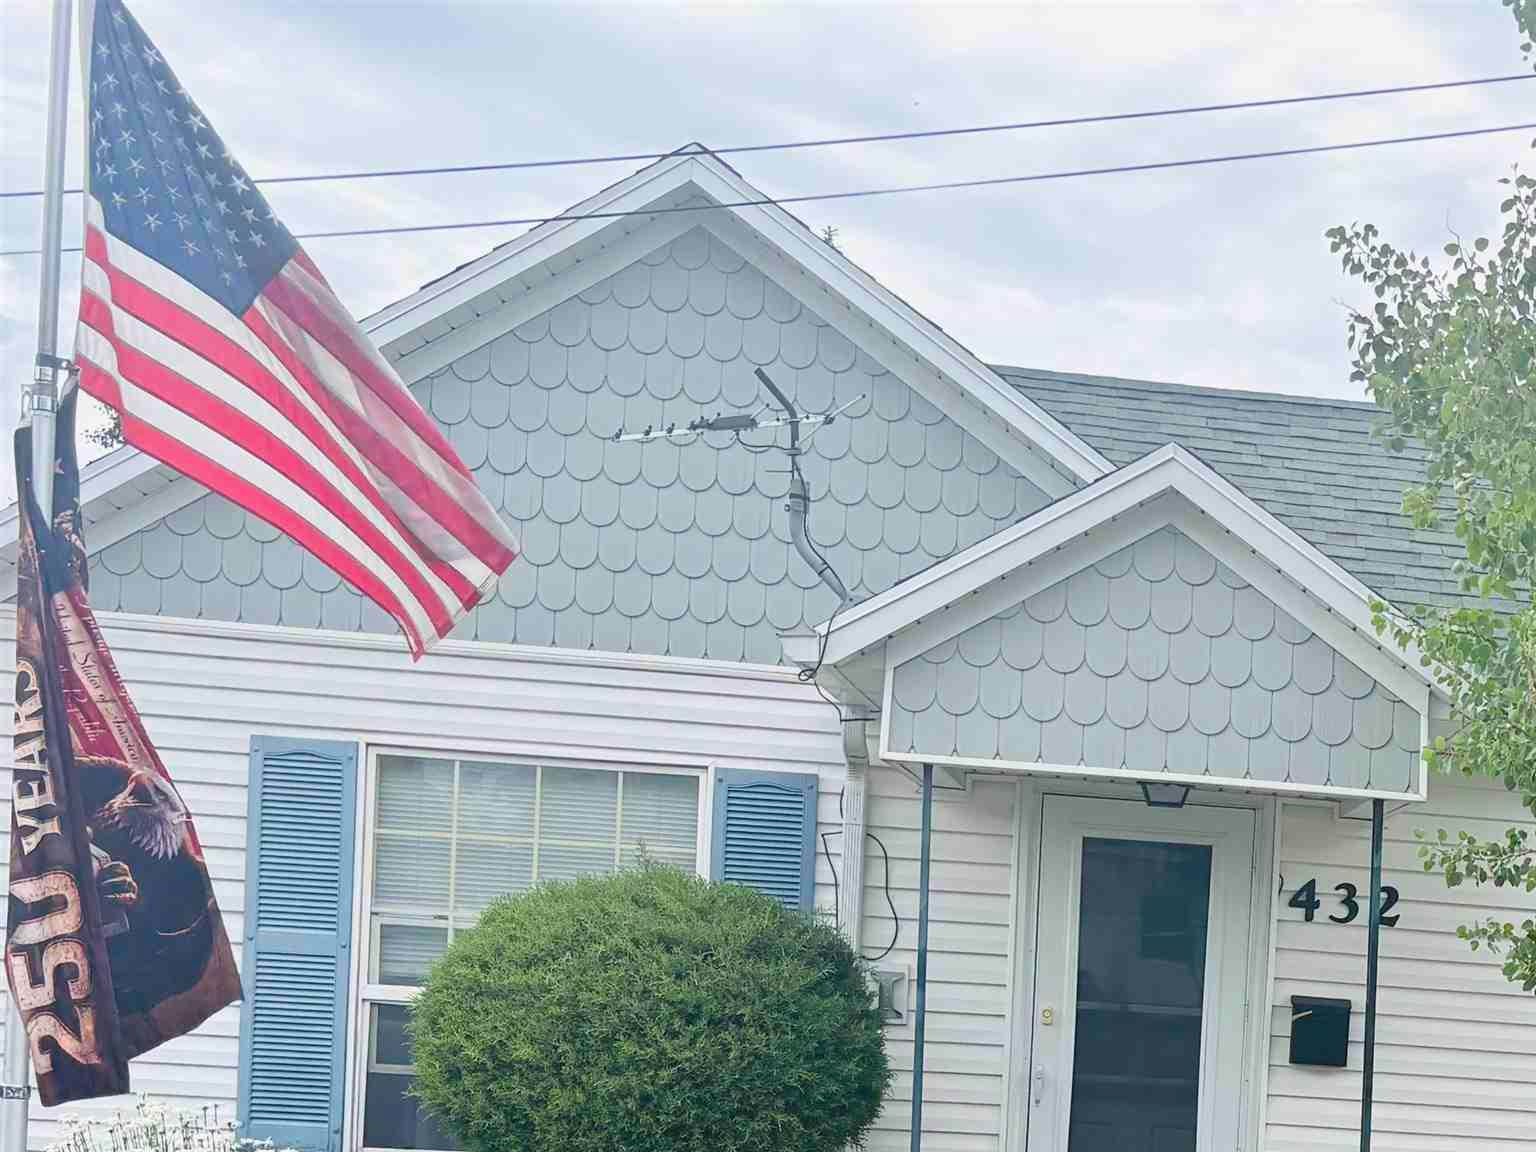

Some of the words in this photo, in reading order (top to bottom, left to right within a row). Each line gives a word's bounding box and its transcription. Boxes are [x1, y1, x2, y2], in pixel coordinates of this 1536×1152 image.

[73, 650, 102, 690] States
[14, 656, 62, 856] YEARS
[1278, 873, 1401, 928] 432
[9, 870, 104, 1075] 250
